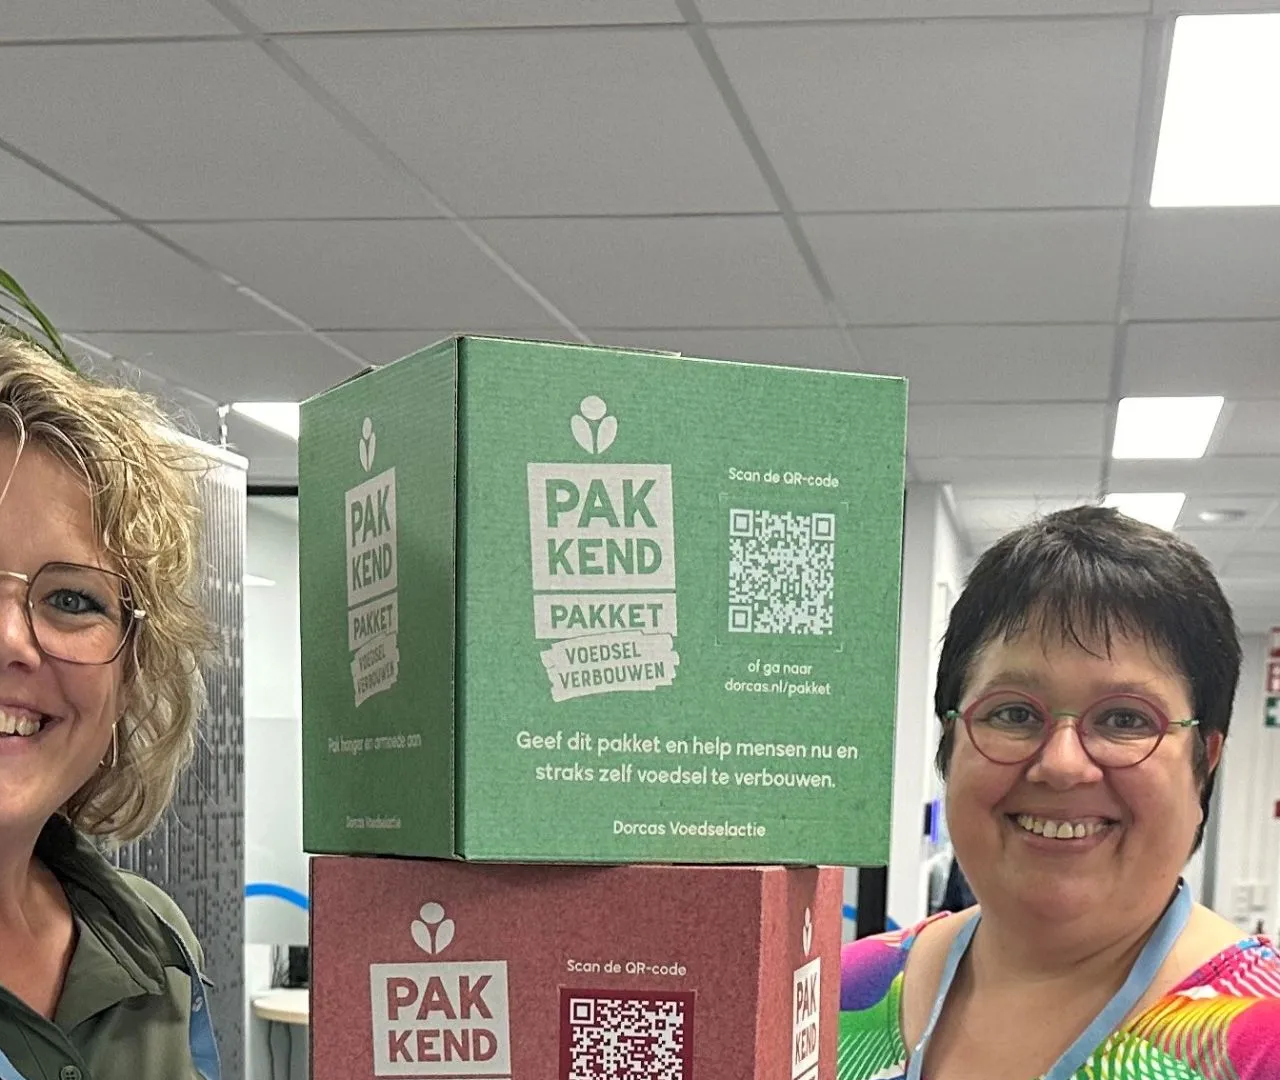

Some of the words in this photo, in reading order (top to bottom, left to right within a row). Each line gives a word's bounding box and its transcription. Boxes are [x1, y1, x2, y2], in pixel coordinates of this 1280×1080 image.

[729, 468, 760, 483] Scan
[763, 470, 780, 484] de
[783, 471, 839, 488] QR-code
[351, 485, 391, 547] PAK
[545, 479, 657, 528] PAK
[352, 542, 392, 591] KEND
[547, 538, 662, 575] KEND
[354, 604, 393, 641] PAKKET
[550, 603, 663, 629] PAKKET
[565, 642, 641, 664] VOEDSEL
[559, 662, 665, 689] VERBOUWEN
[748, 660, 762, 674] of
[763, 663, 780, 677] ga
[783, 663, 812, 675] naar
[725, 679, 831, 696] dorcas.nl/pakket
[517, 731, 563, 750] Geef
[567, 733, 592, 752] dit
[597, 735, 661, 755] pakket
[665, 740, 688, 754] en
[692, 737, 732, 759] help
[736, 743, 807, 758] mensen
[811, 745, 833, 758] nu
[837, 746, 858, 759] en
[536, 764, 593, 782] straks
[599, 765, 634, 783] zelf
[637, 766, 708, 784] voedsel
[712, 769, 729, 785] te
[734, 767, 836, 788] verbouwen.
[613, 821, 666, 836] Dorcas
[669, 821, 766, 837] Voedselactie
[567, 959, 600, 974] Scan
[604, 960, 621, 975] de
[625, 962, 687, 977] QR-code
[386, 975, 493, 1021] PAK
[796, 972, 817, 1024] PAK
[387, 1029, 498, 1063] KEND
[795, 1022, 817, 1065] KEND
